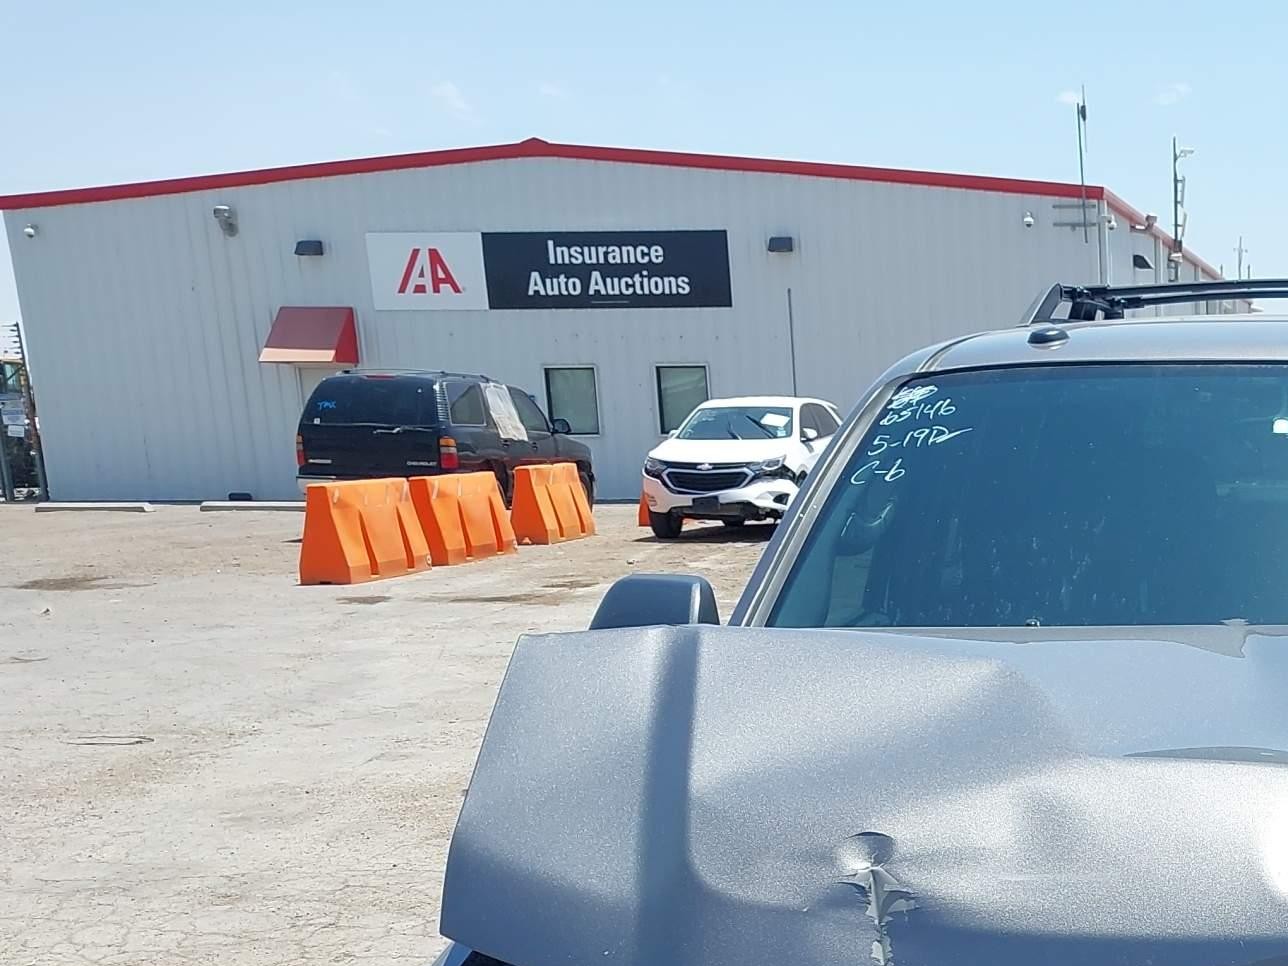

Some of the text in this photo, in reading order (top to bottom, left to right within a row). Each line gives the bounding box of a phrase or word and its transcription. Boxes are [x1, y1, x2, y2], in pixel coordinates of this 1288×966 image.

[547, 239, 664, 266] Insurance
[527, 269, 691, 296] Auto Auctions
